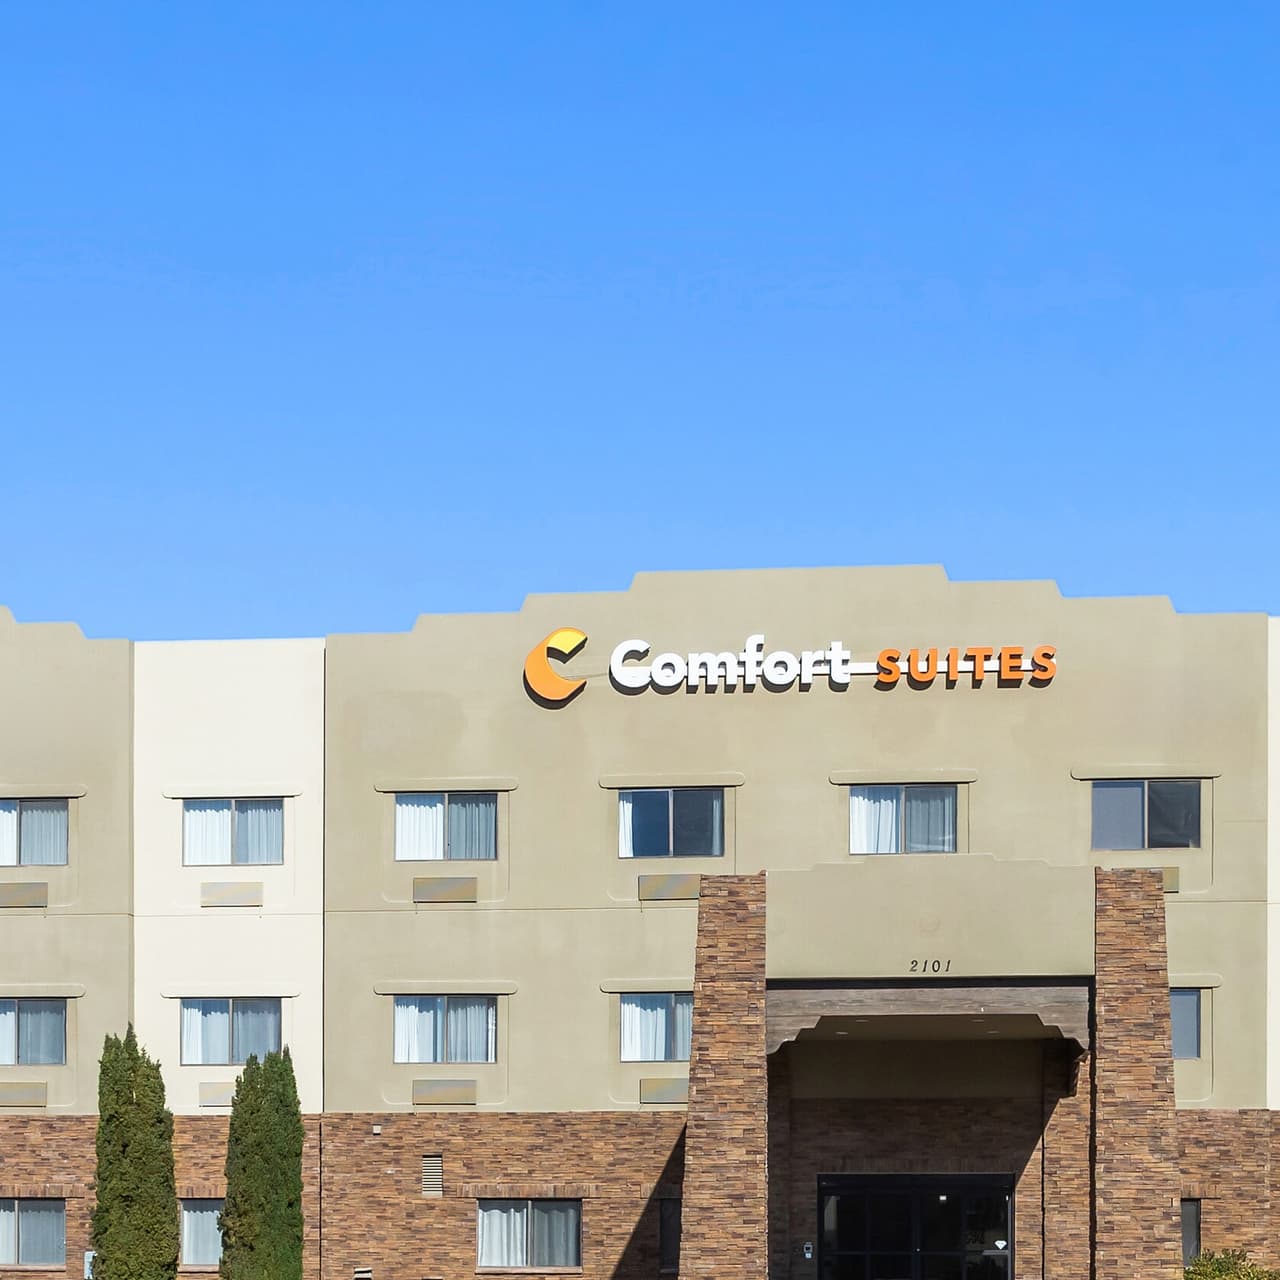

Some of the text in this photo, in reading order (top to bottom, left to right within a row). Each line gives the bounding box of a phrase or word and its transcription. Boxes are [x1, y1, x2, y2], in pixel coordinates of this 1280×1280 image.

[609, 634, 851, 692] Comfort
[875, 645, 1057, 685] SUITES
[909, 959, 951, 973] 2101
